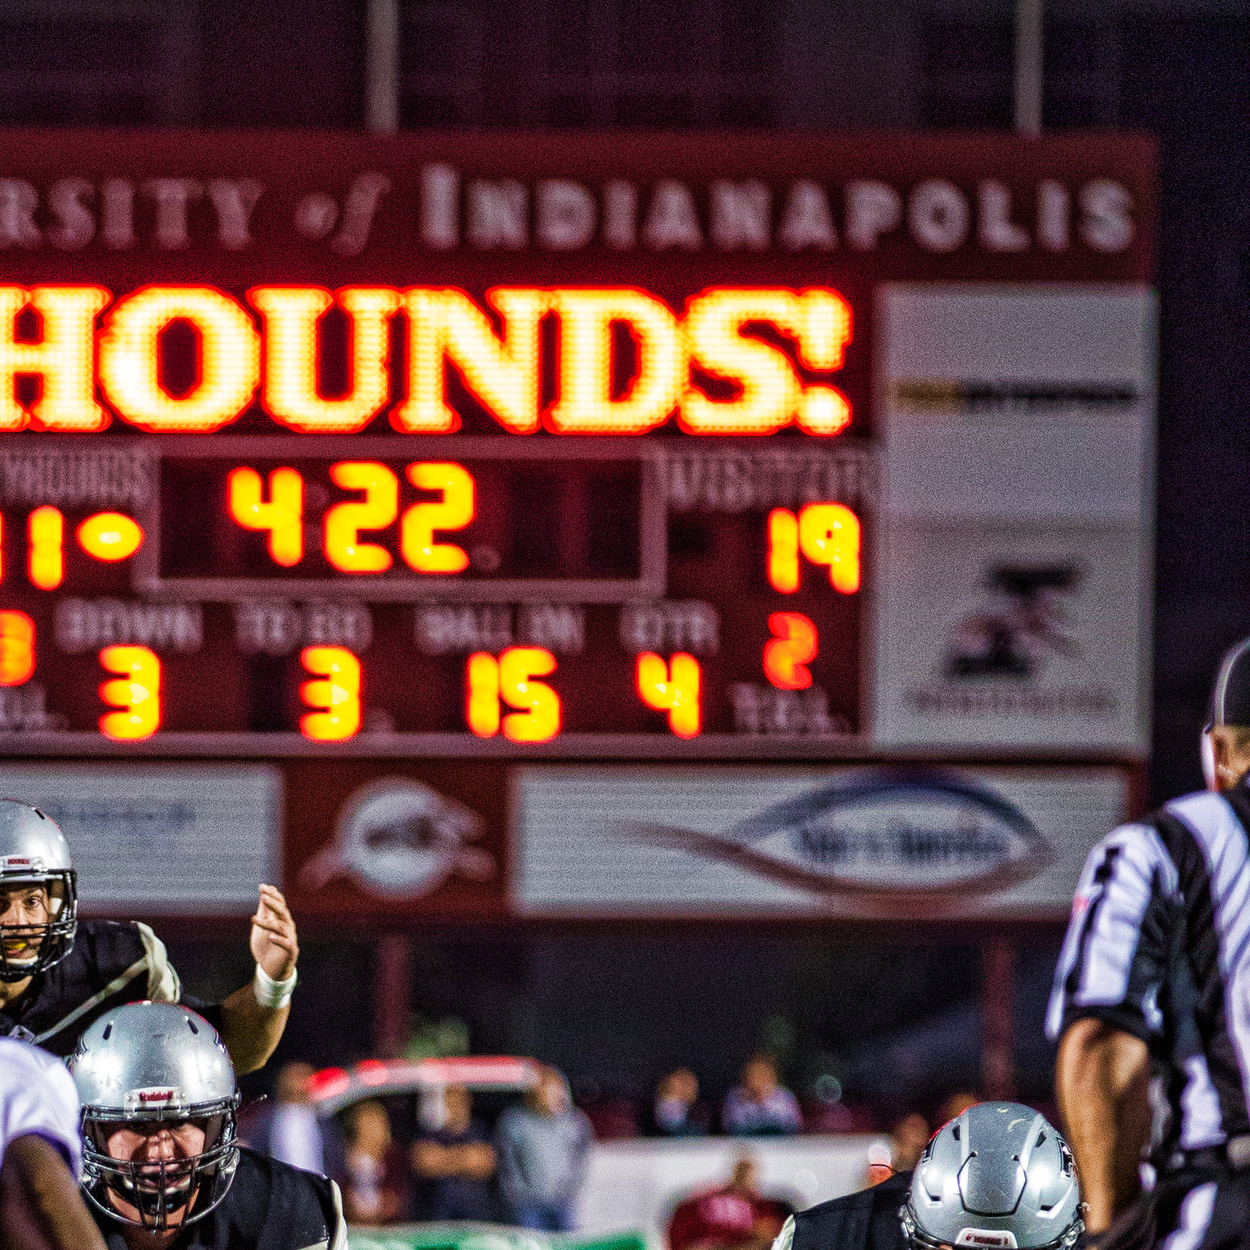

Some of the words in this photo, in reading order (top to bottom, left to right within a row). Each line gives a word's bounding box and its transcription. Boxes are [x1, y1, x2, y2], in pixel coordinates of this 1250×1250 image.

[294, 171, 391, 256] of
[767, 502, 861, 594] 19
[99, 643, 163, 742] 3
[299, 643, 363, 742] 3
[466, 646, 562, 743] 15
[636, 651, 701, 739] 4
[763, 612, 819, 690] 2
